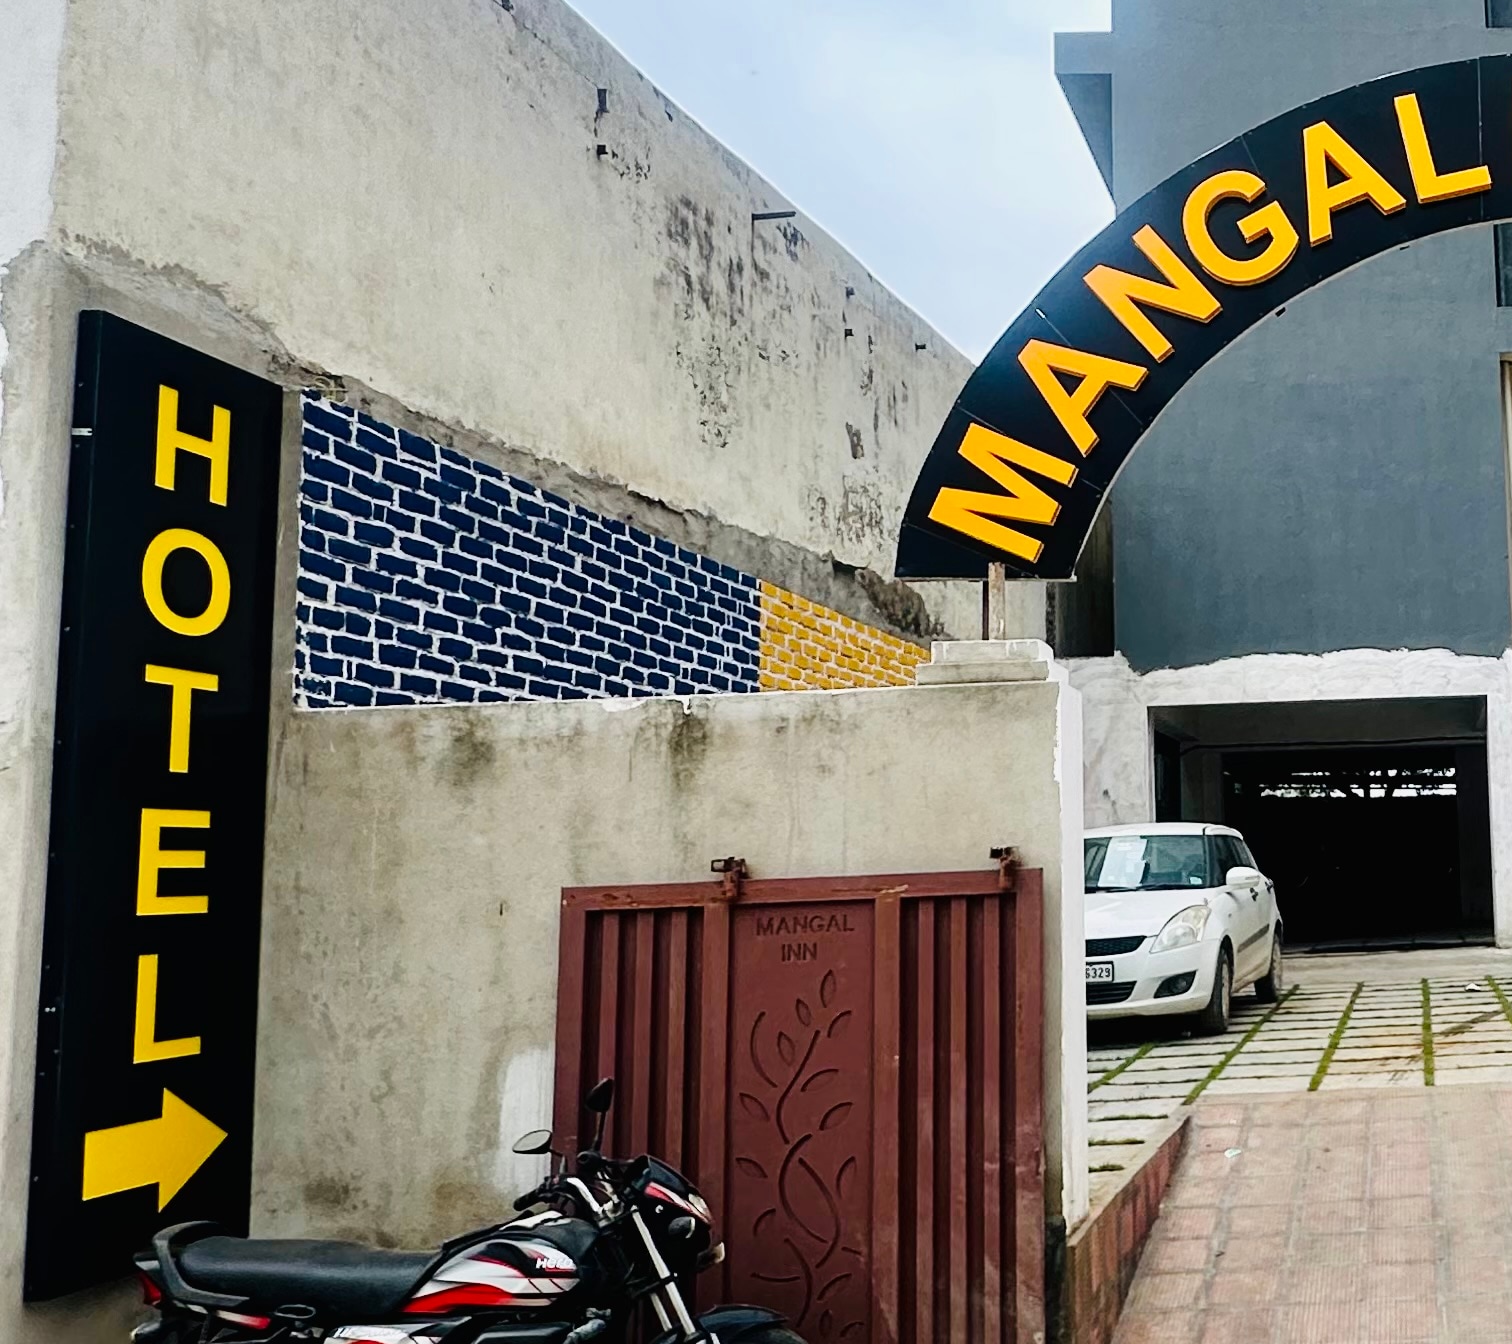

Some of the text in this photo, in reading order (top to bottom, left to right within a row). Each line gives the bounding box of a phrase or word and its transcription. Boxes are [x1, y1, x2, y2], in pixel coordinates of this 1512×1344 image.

[928, 94, 1495, 565] MANGAL
[132, 383, 232, 1065] HOTEL
[755, 914, 855, 936] MANGAL
[781, 942, 818, 962] INN
